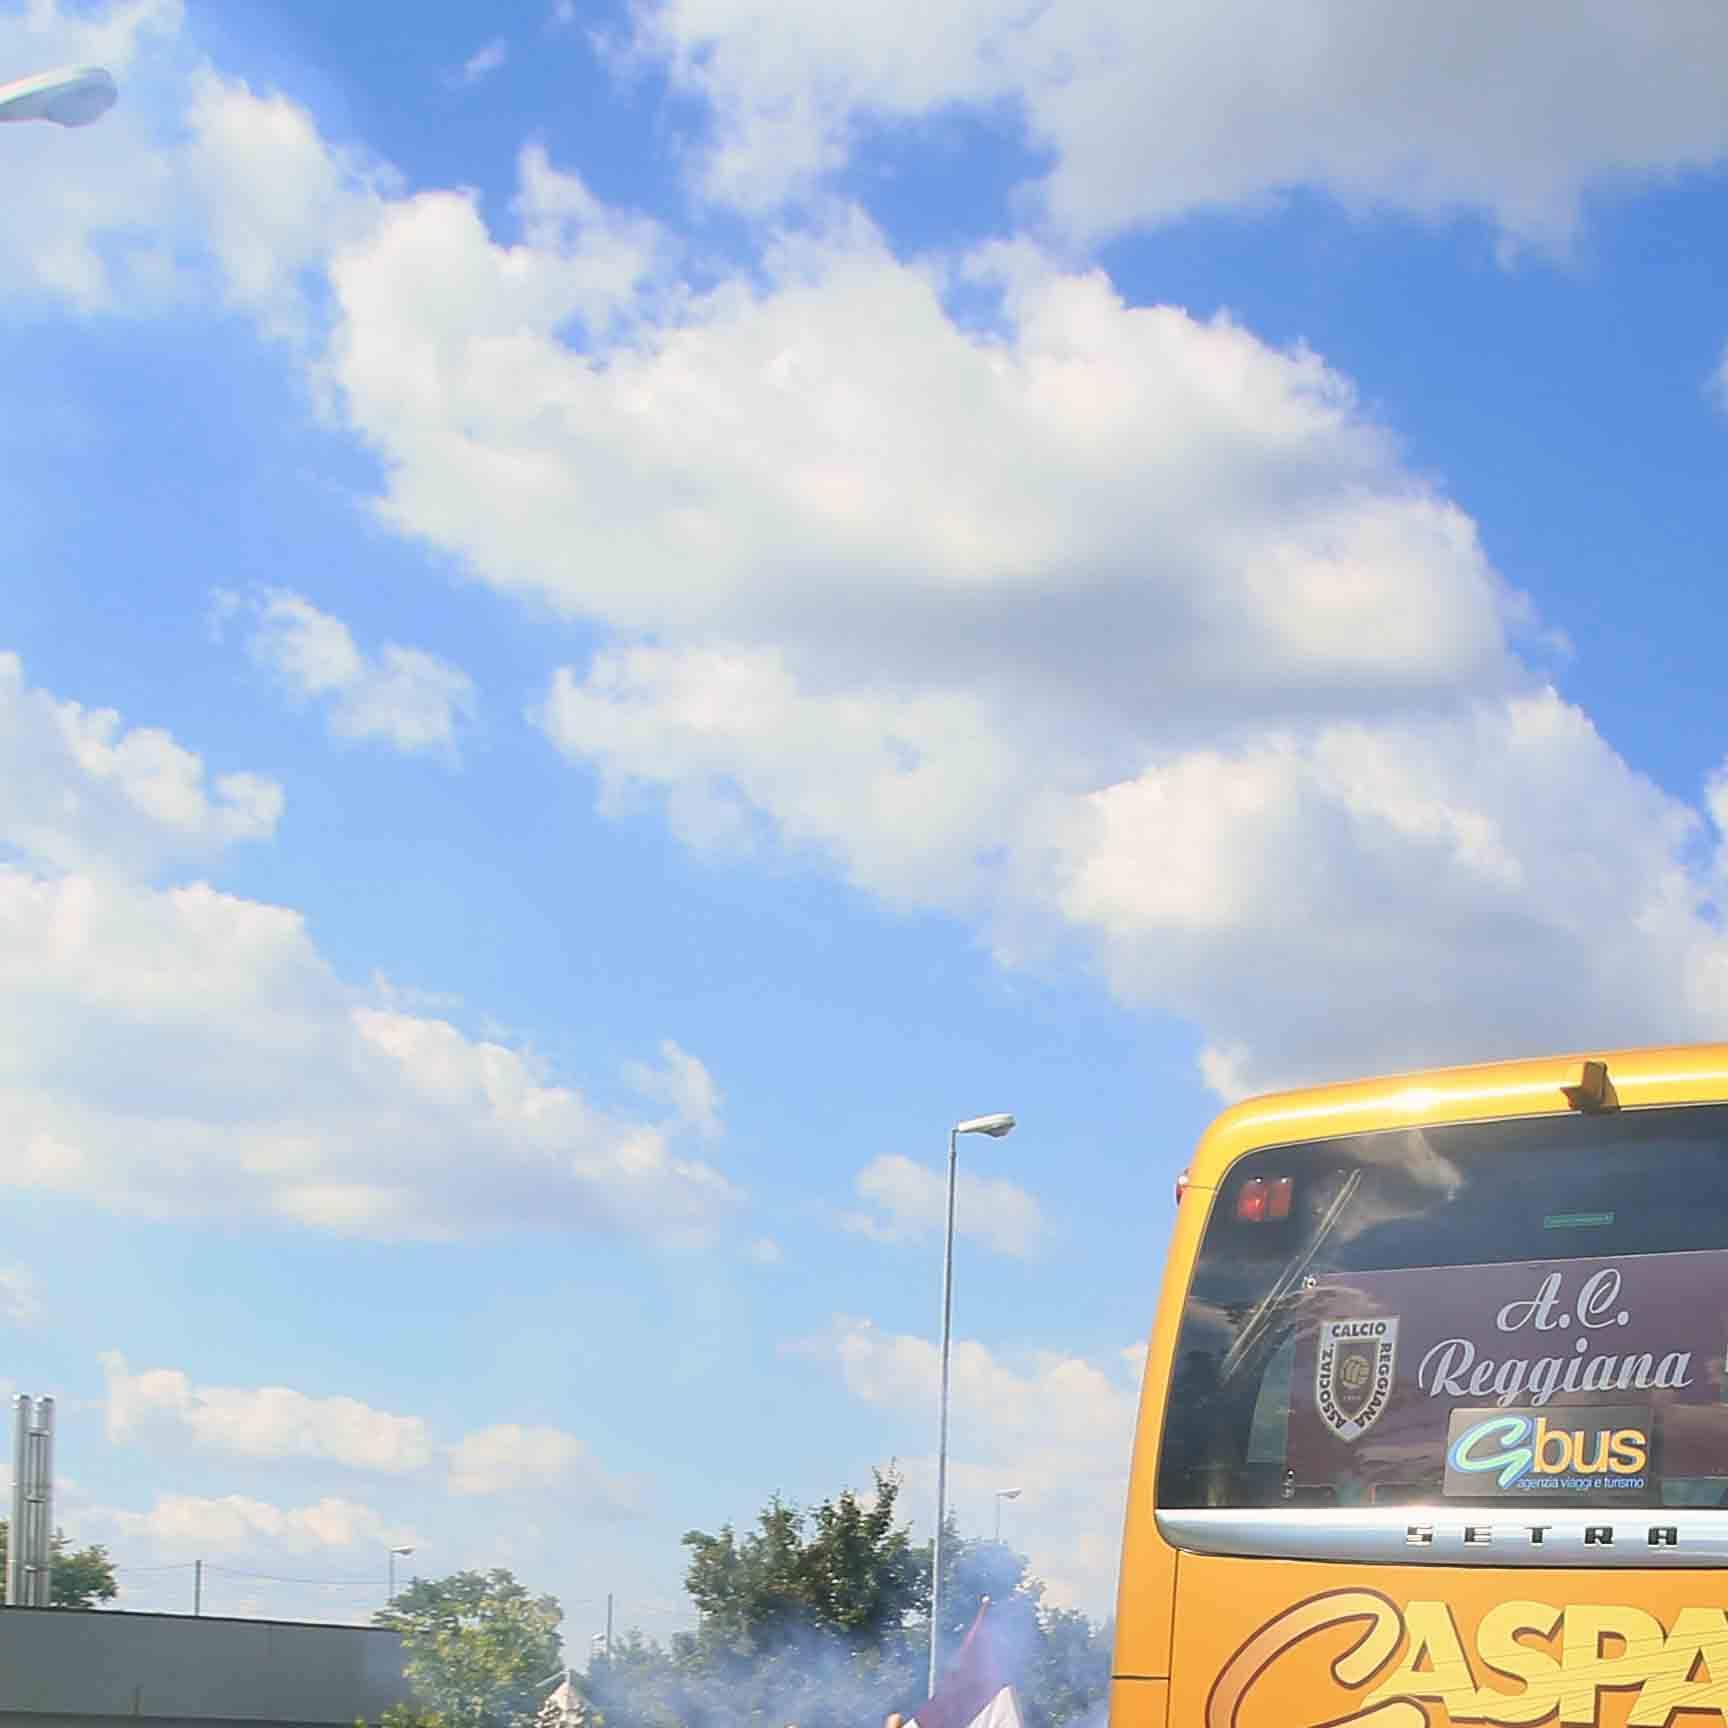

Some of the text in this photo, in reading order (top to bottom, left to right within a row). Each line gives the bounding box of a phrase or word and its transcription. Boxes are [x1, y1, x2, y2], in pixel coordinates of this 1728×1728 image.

[1496, 1268, 1629, 1332] A.C.
[1331, 1322, 1387, 1337] CALCIO
[1353, 1343, 1393, 1428] REGGIANA
[1417, 1337, 1694, 1408] Reggiana
[1517, 1477, 1645, 1490] agenzia viaggi e turismo
[1406, 1525, 1679, 1547] SETRA
